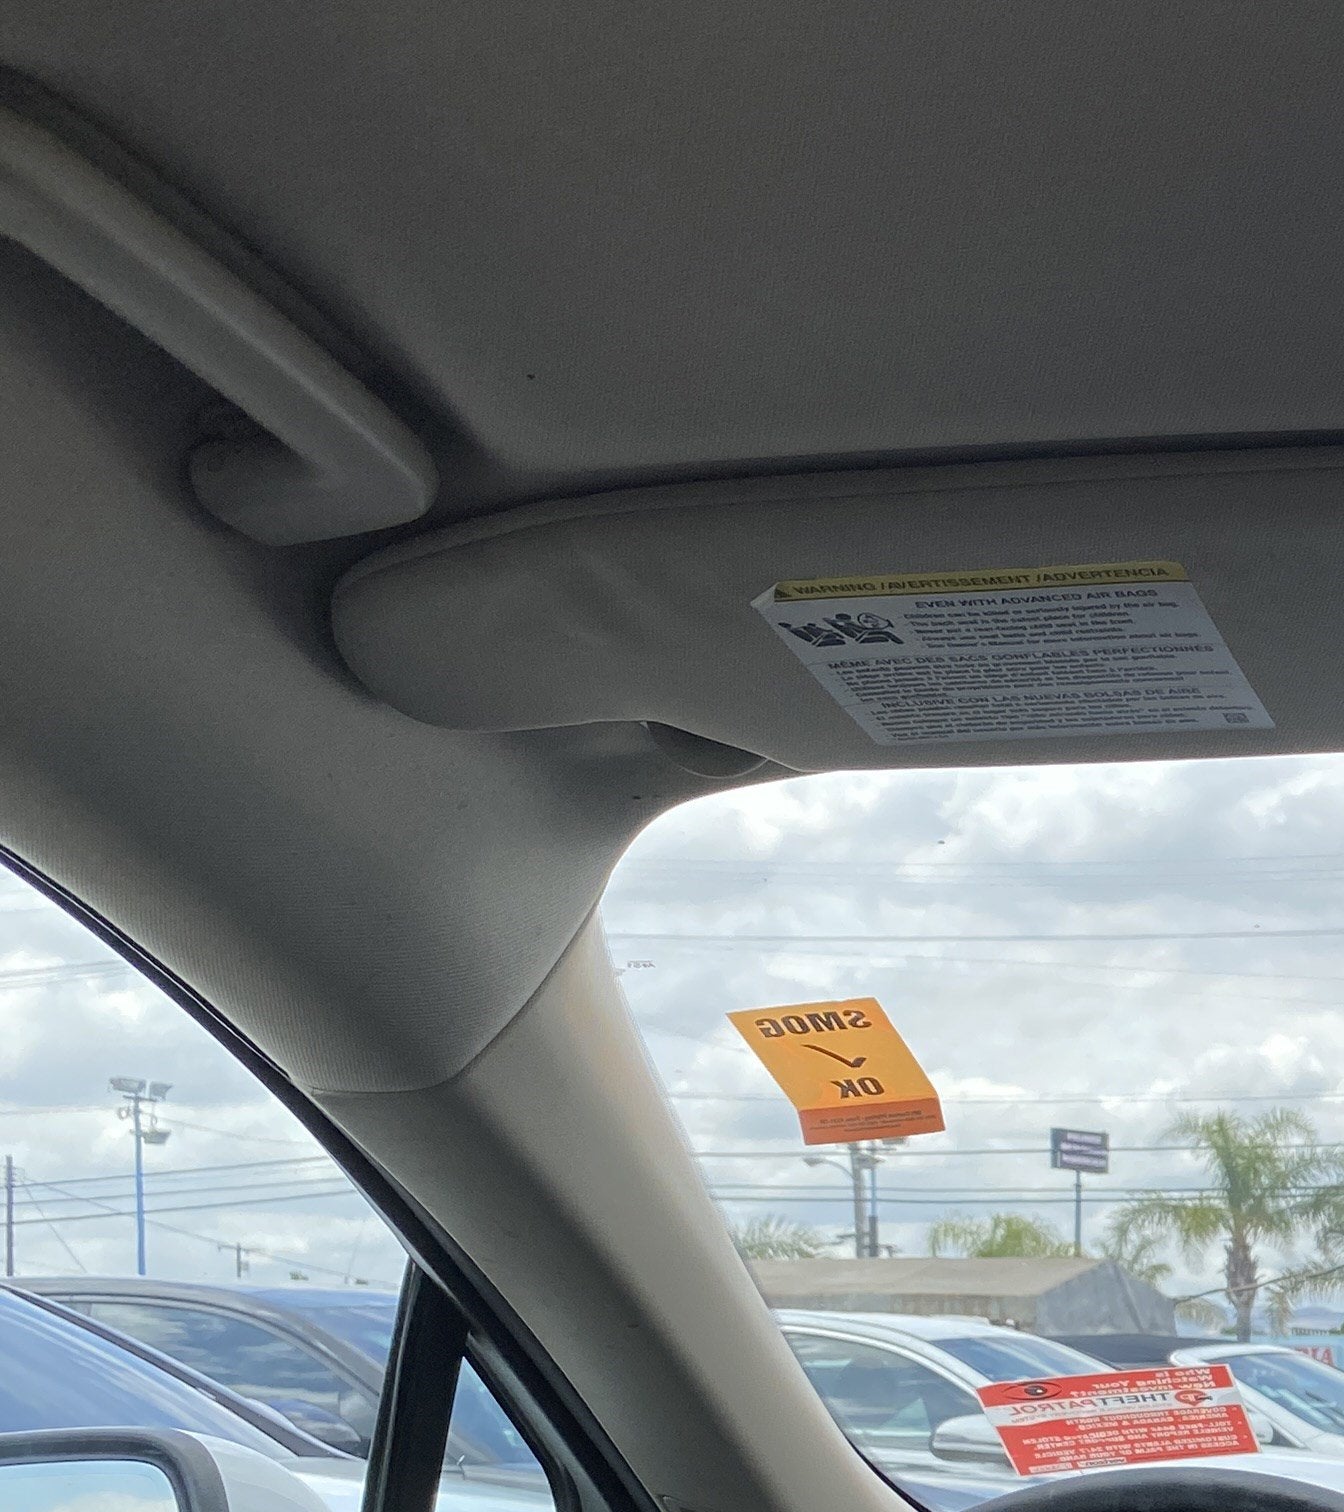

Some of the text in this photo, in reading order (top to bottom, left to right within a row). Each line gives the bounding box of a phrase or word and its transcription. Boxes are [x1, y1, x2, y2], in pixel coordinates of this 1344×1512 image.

[791, 583, 877, 595] WARNING
[914, 588, 1158, 608] EVEN WITH ADVANCED AIR BAGS
